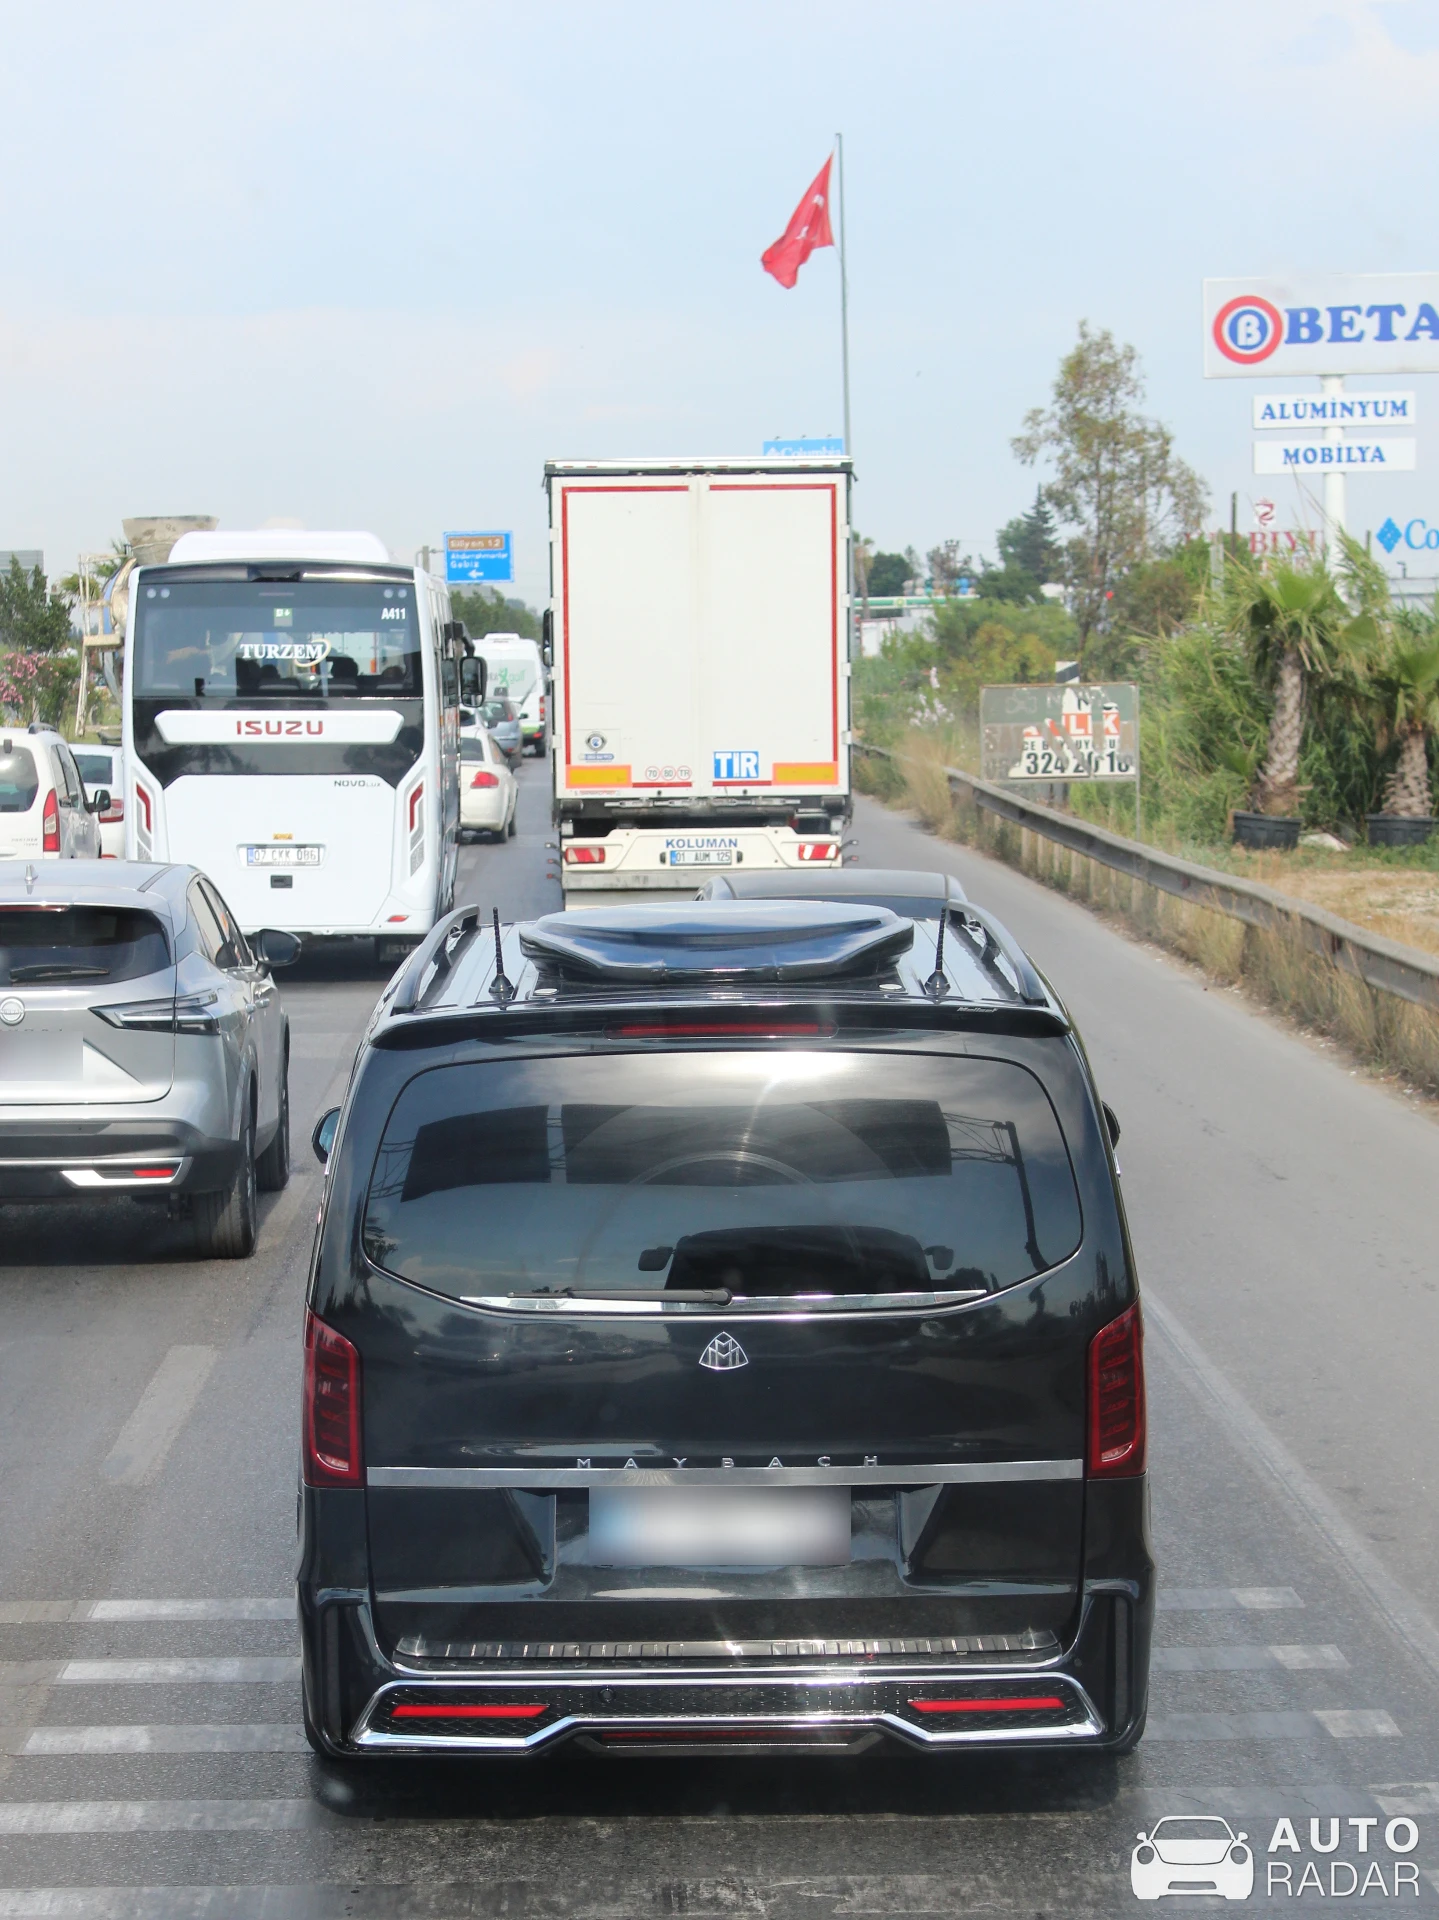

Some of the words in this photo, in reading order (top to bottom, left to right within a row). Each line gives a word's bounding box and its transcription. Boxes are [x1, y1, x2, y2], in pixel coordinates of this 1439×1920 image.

[1284, 303, 1439, 344] BETA
[1260, 397, 1408, 421] ALÜMİNYUM
[1282, 442, 1386, 465] MOBİLYA
[381, 607, 406, 620] A411
[240, 643, 324, 660] TURZEM
[236, 720, 324, 736] ISUZU
[715, 752, 758, 778] TIR
[665, 838, 738, 849] KOLUMAN
[694, 852, 711, 862] AUM
[716, 851, 731, 861] 125
[576, 1456, 878, 1469] MAYBACH
